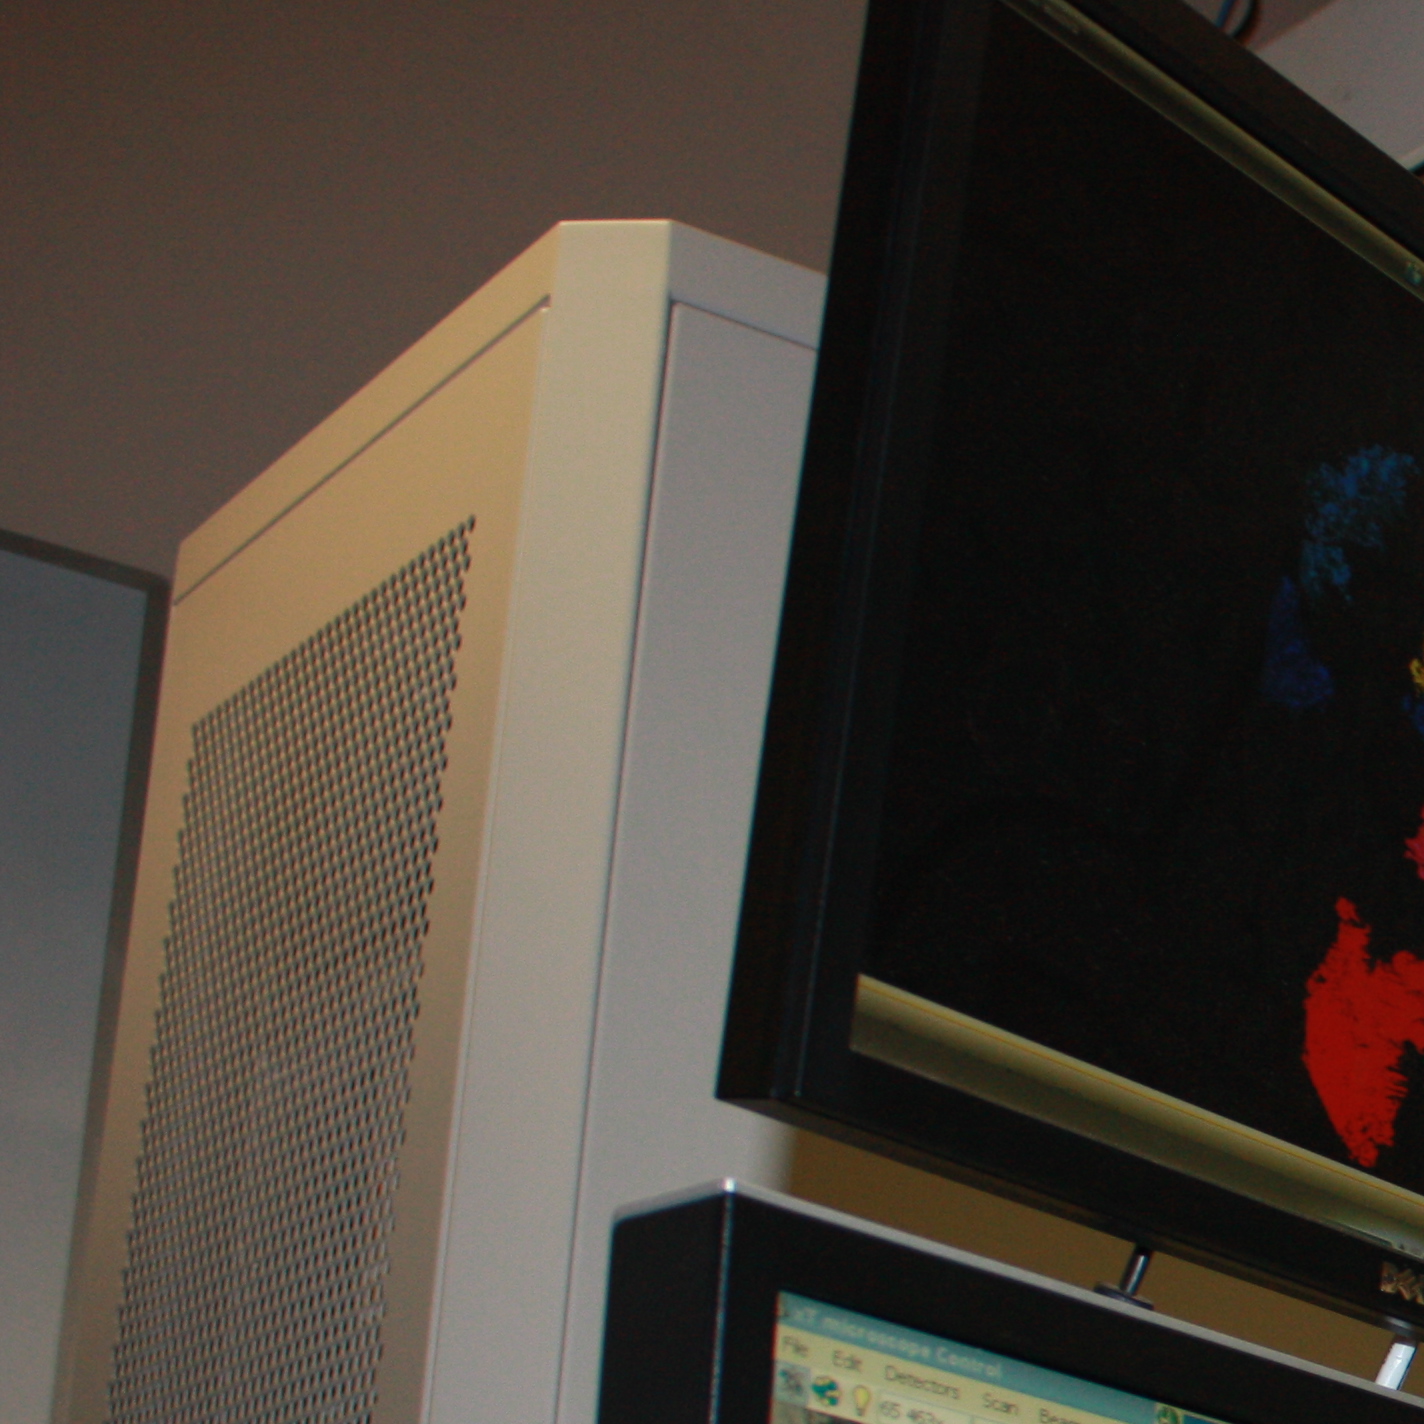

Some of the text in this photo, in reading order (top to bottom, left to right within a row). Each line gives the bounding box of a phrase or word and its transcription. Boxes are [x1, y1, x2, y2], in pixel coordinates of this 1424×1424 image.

[783, 1335, 808, 1358] File
[833, 1351, 863, 1372] Edit
[885, 1365, 961, 1400] Detectors
[981, 1393, 1020, 1416] Scan
[821, 1316, 932, 1359] microscope
[935, 1347, 1001, 1377] Control
